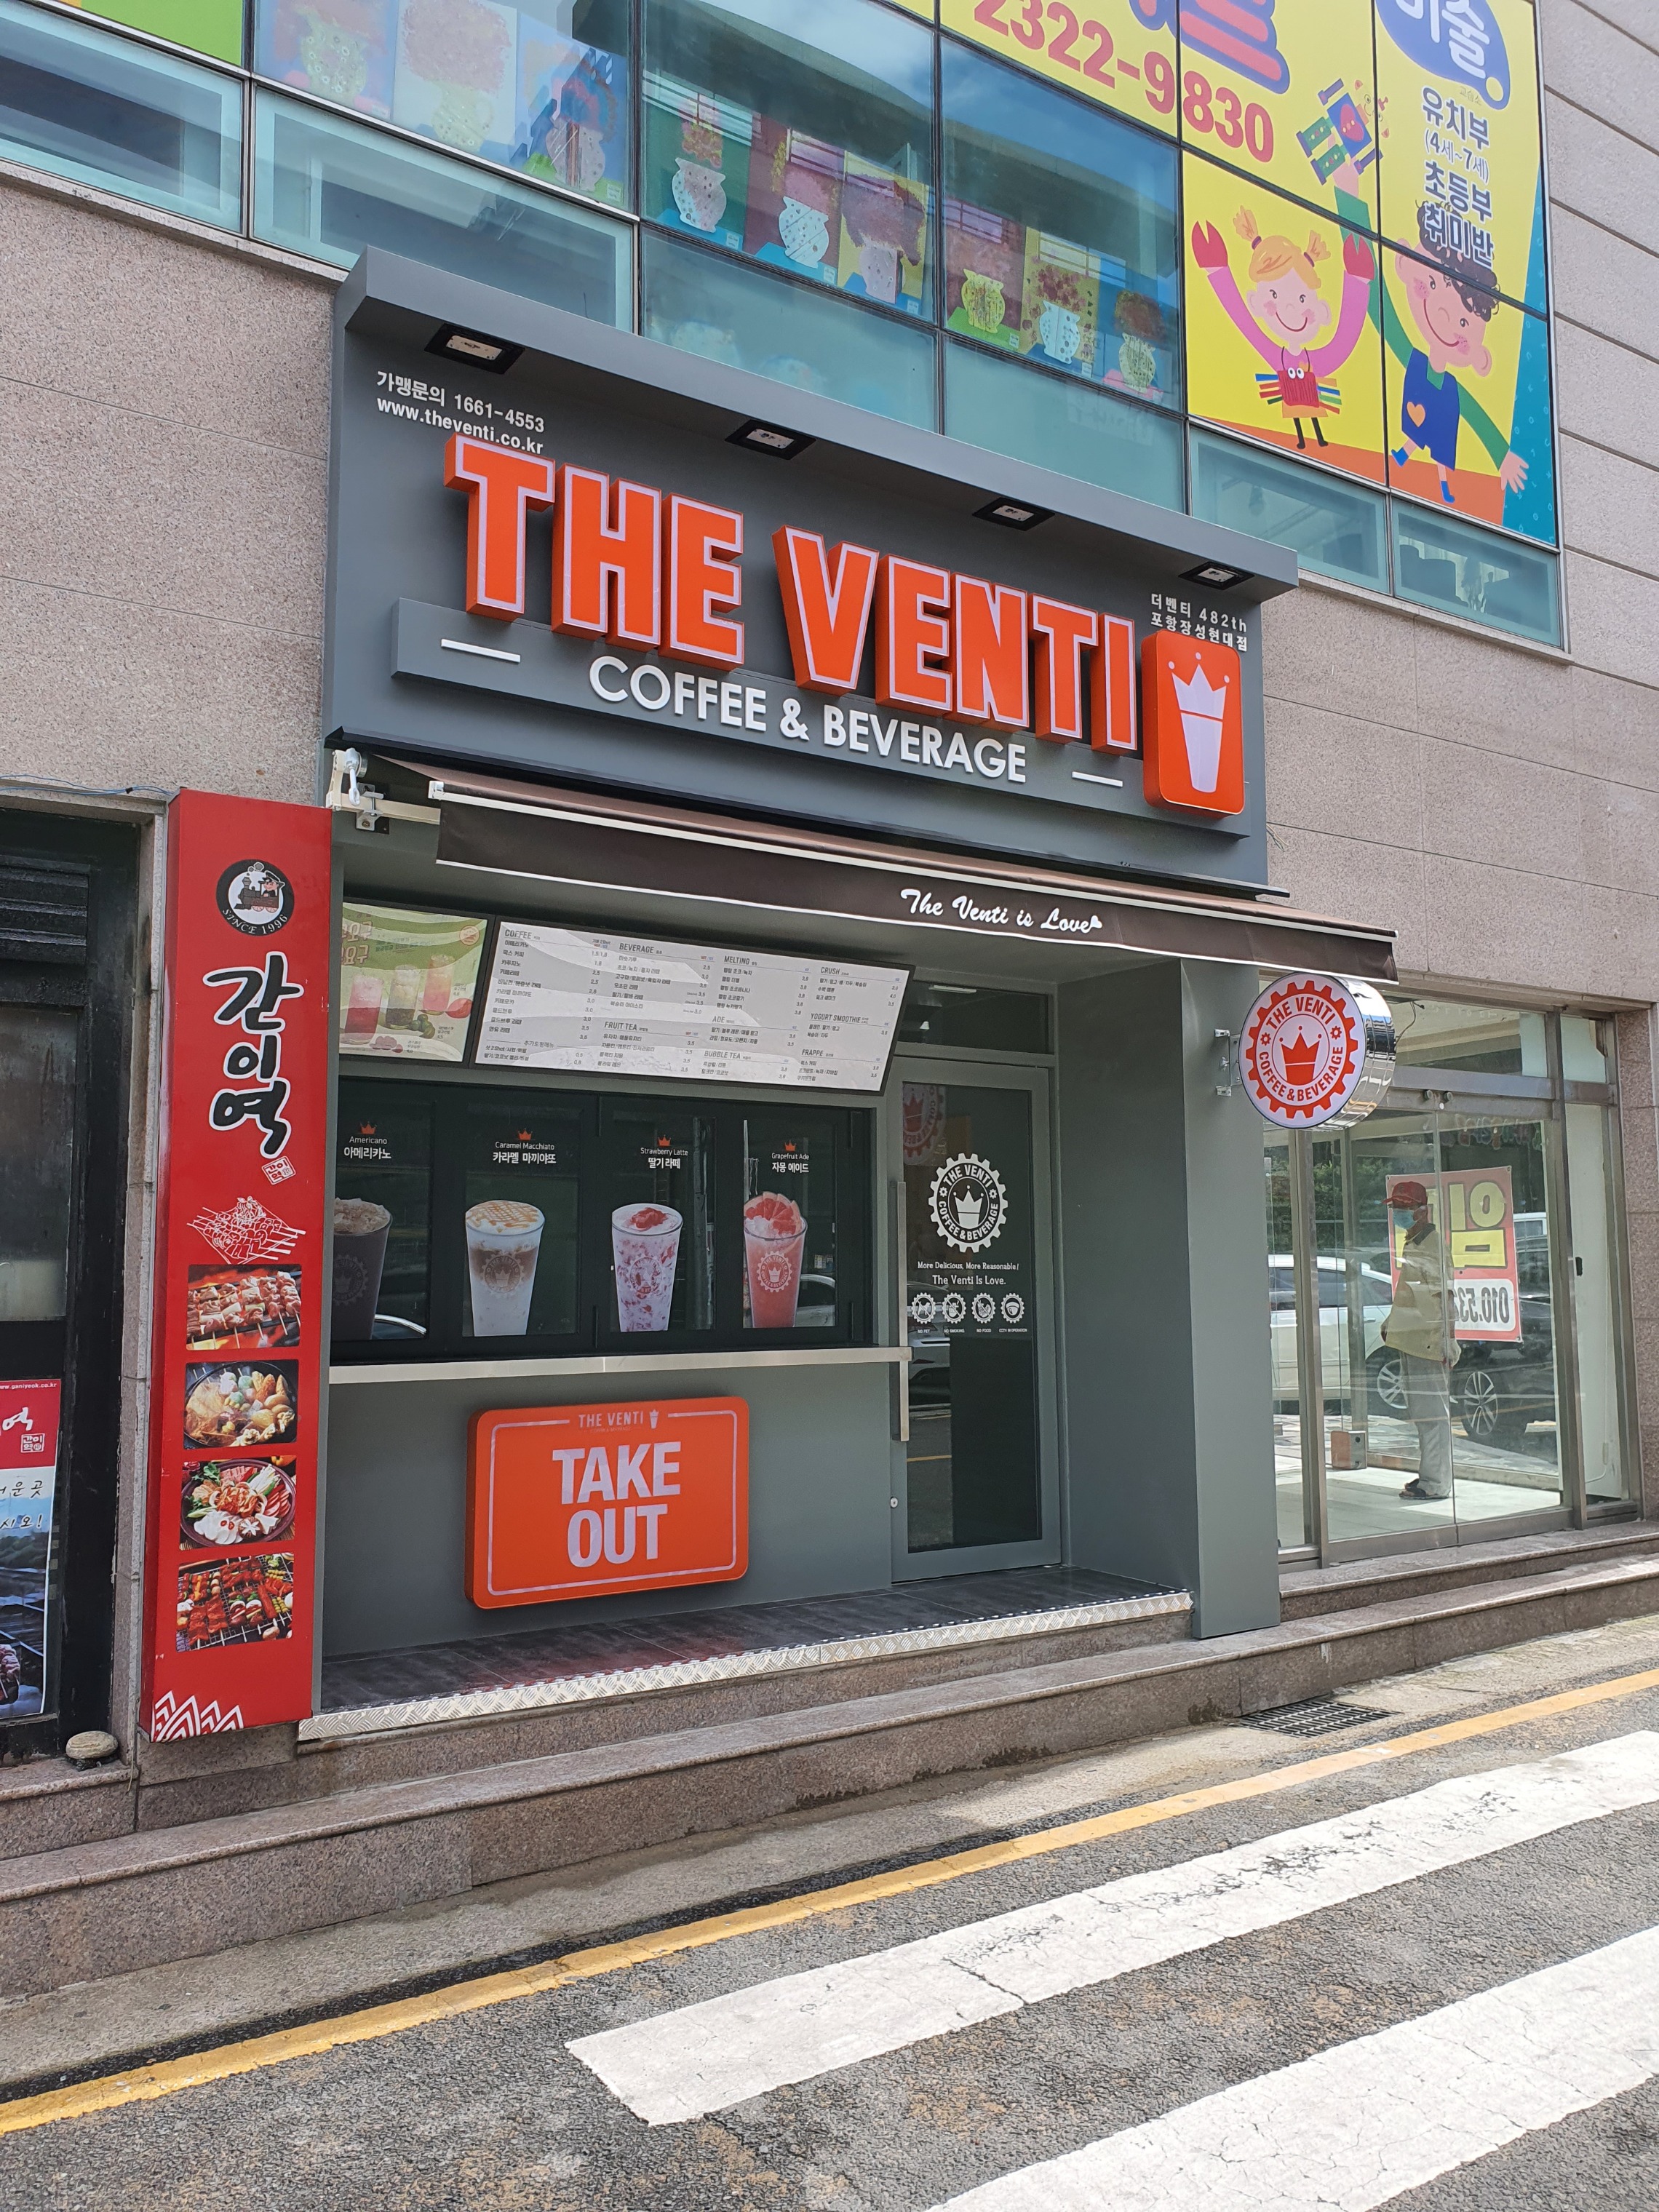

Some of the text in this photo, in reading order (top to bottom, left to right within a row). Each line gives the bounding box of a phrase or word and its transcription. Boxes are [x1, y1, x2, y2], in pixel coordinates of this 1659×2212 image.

[1422, 87, 1489, 150] 유치부
[1425, 129, 1489, 183] (4세~7세)
[1425, 161, 1492, 222] 초등부
[1424, 203, 1494, 269] 취미반
[377, 371, 544, 433] 가맹문의 1661-4553
[377, 398, 544, 454] www.theventi.co.kr
[444, 432, 1138, 755] THE VENTI
[1151, 593, 1246, 632] 더벤티 482th
[1150, 612, 1247, 652] 포항장성현대점
[589, 656, 1027, 784] COFFEE & BEVERAGE
[900, 888, 1091, 934] The Venti is Love
[222, 909, 287, 934] SINCE 1996
[505, 929, 532, 939] COFFEE
[619, 942, 655, 953] BEVERAGE
[724, 955, 750, 965] MELTING
[820, 966, 840, 975] CRUSH
[811, 1013, 832, 1021] YOGURT
[833, 1014, 861, 1023] SMOOTHIE
[1266, 996, 1336, 1030] THE VENTI
[604, 1021, 624, 1030] FRUIT
[203, 952, 304, 1159] 간이역
[704, 1050, 728, 1059] BUBBLE
[801, 1049, 824, 1057] FRAPPE
[349, 1136, 388, 1145] Americano
[495, 1141, 555, 1150] Caramel Macchiato
[343, 1147, 392, 1160] 아메리카노
[493, 1151, 557, 1164] 카라멜 마끼야또
[640, 1147, 688, 1157] Strawberry Latte
[771, 1153, 797, 1161] Grapefruit
[648, 1158, 681, 1169] 딸기 라떼
[772, 1162, 809, 1174] 자몽 에이드
[943, 1165, 992, 1187] THE VENTI
[918, 1261, 1019, 1270] More Delicious, More Reasonable!
[932, 1275, 1006, 1286] The Venti Is Love.
[578, 1411, 644, 1428] THE VENTI
[552, 1441, 681, 1505] TAKE
[568, 1503, 668, 1568] OUT
